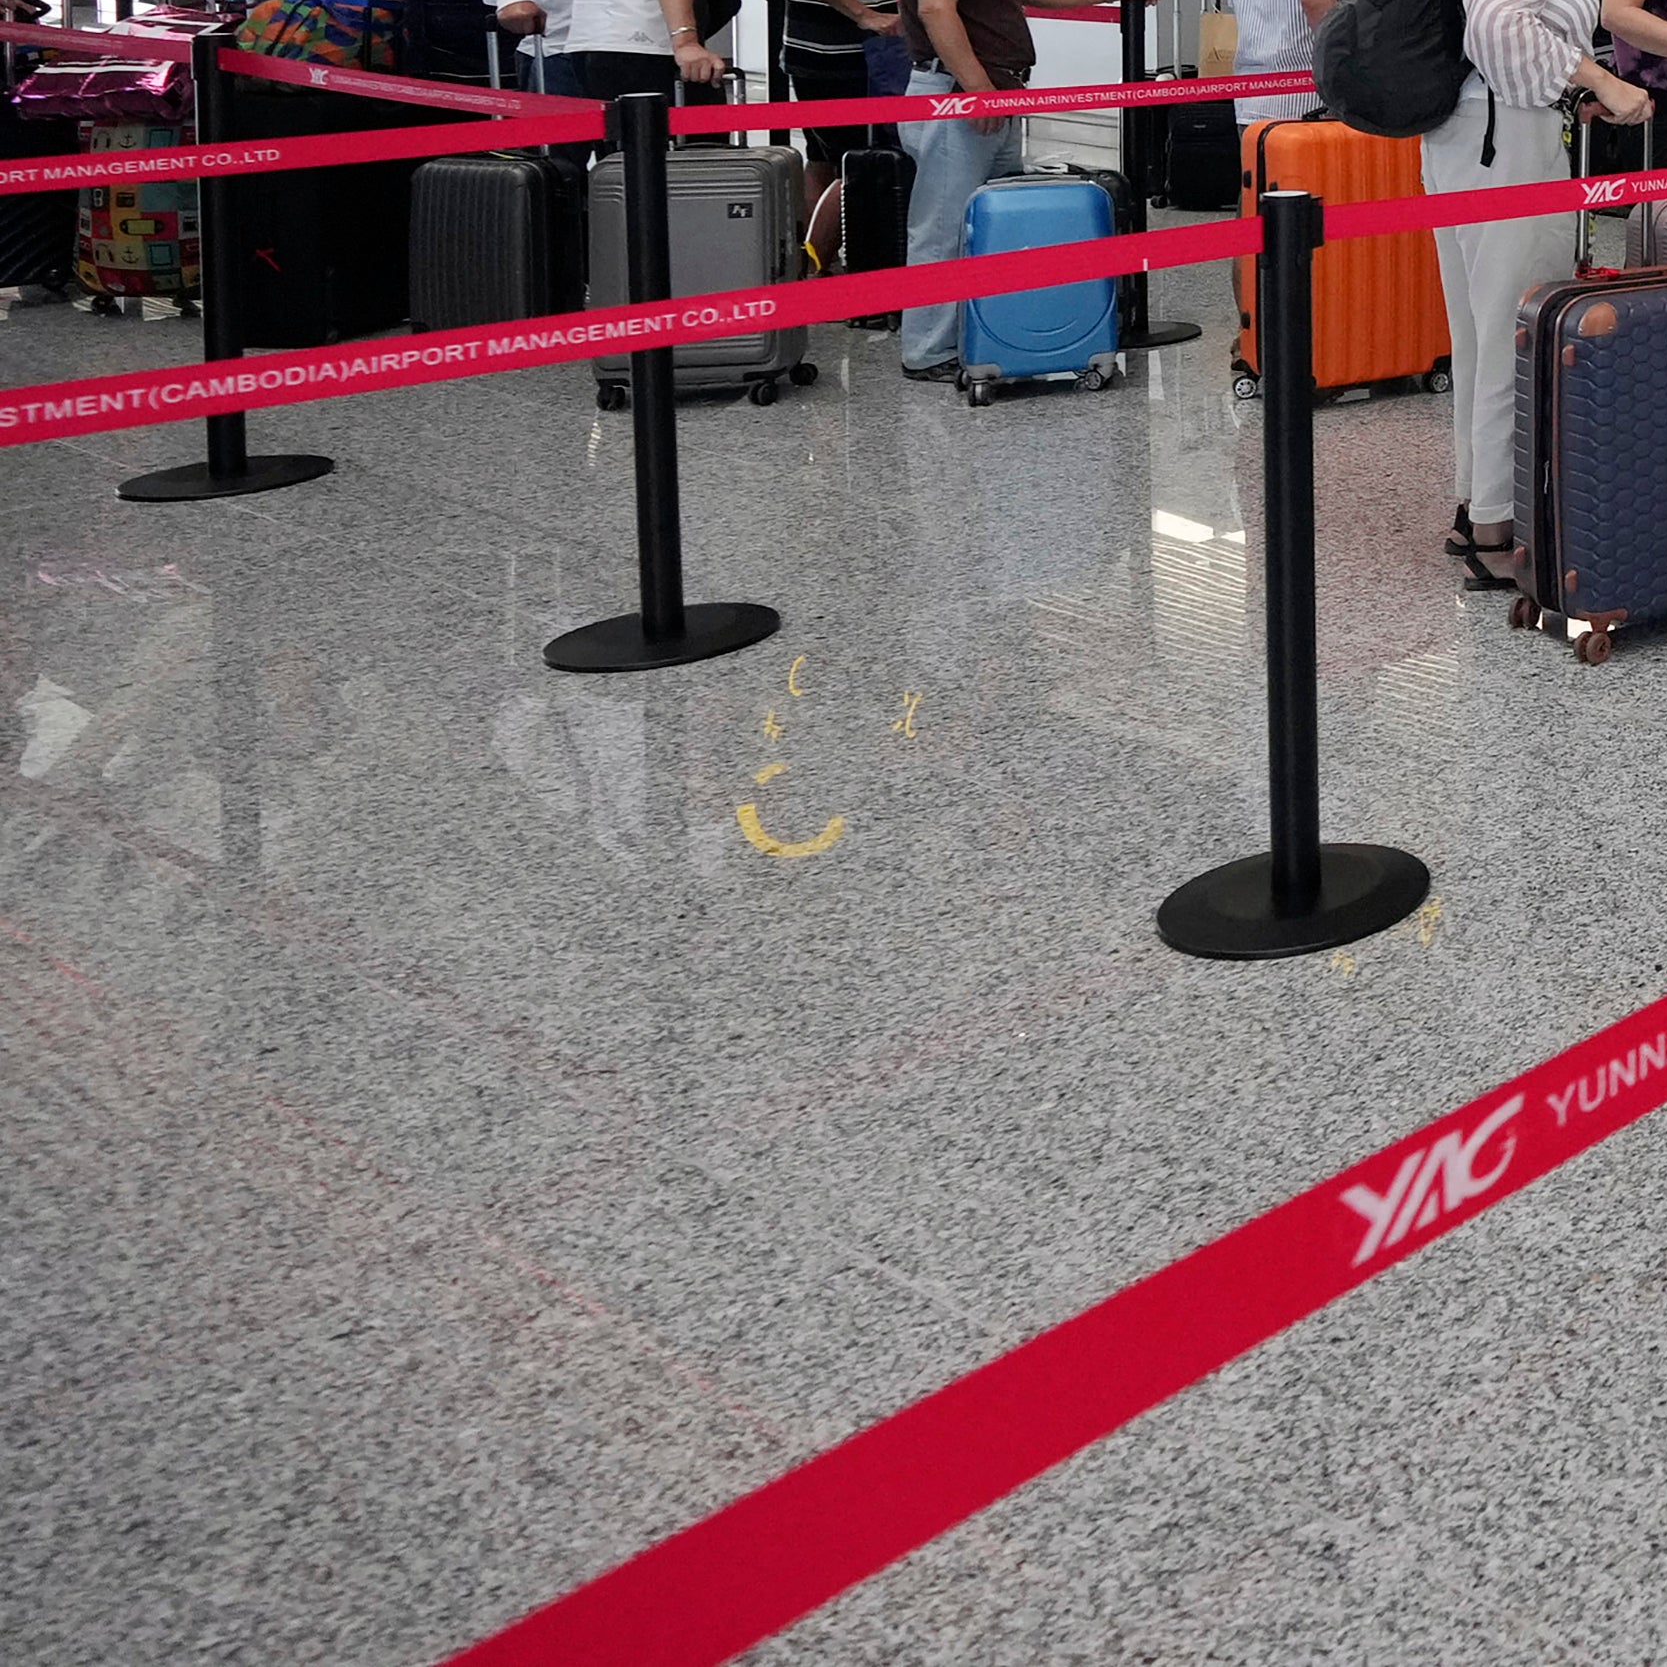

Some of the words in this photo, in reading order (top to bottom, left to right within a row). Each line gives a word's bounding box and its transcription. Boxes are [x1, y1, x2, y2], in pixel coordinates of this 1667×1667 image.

[981, 94, 1036, 110] YUNNAN
[1248, 76, 1314, 91] MANAGEMEN
[43, 156, 198, 180] MANAGEMENT
[487, 313, 678, 358] MANAGEMENT
